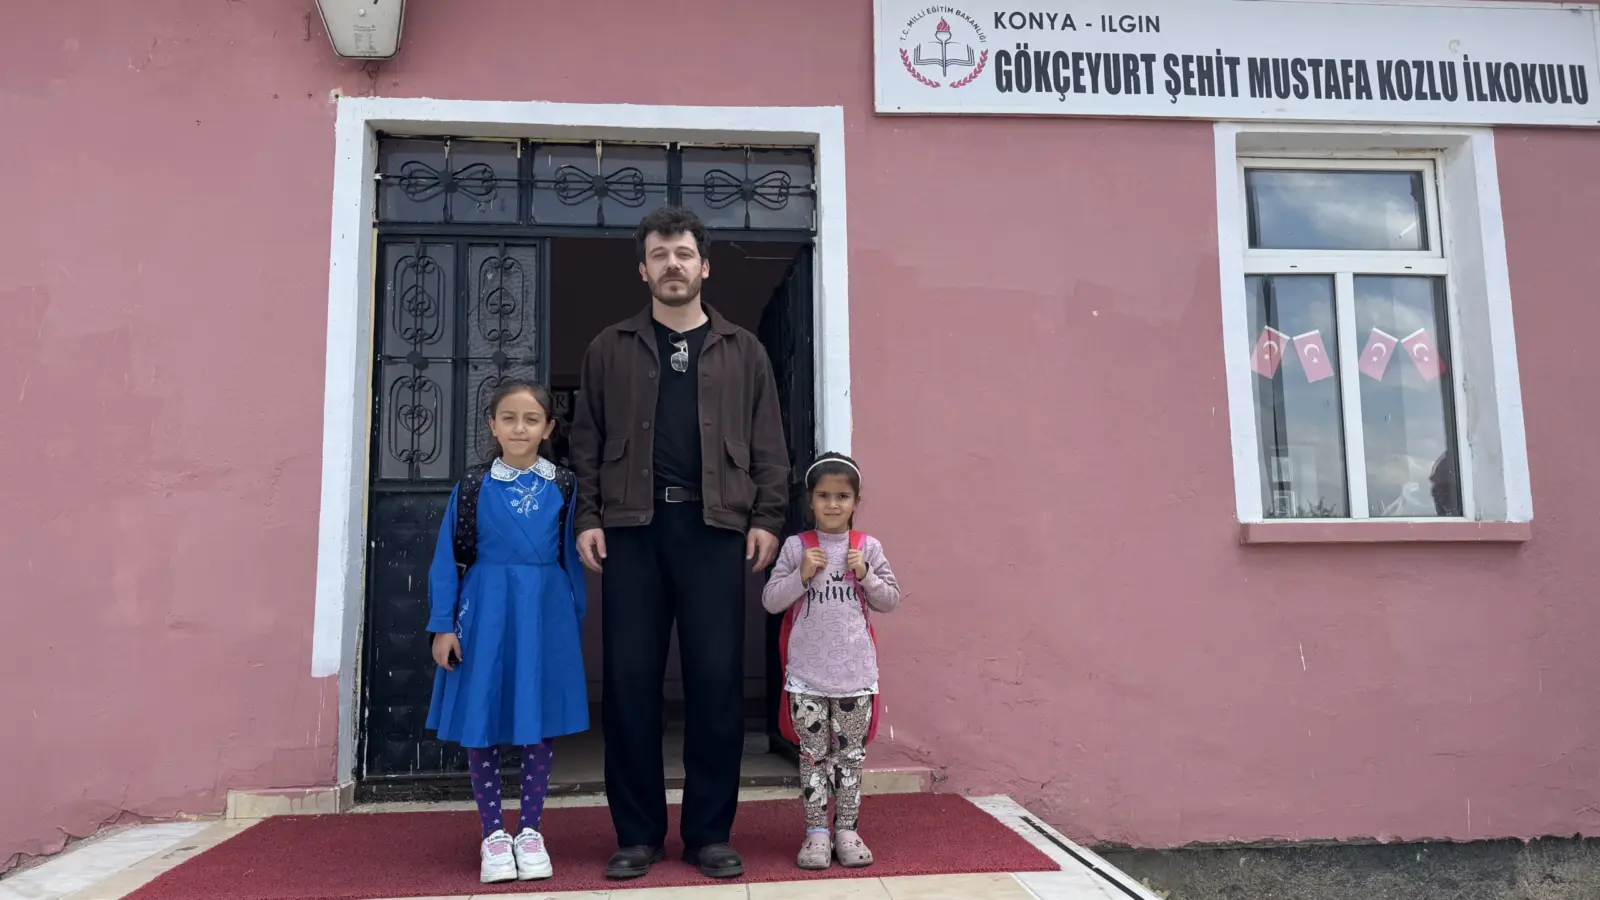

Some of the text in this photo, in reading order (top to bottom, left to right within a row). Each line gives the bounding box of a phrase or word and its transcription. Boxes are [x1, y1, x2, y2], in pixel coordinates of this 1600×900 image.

[900, 5, 987, 43] T.C. MİLLİ EĞİTİM BAKANLIĞI
[995, 12, 1076, 31] KONYA
[1102, 15, 1159, 33] ILGIN
[995, 43, 1588, 104] GÖKÇEYURT ŞEHİT MUSTAFA KOZLU İLKOKULU
